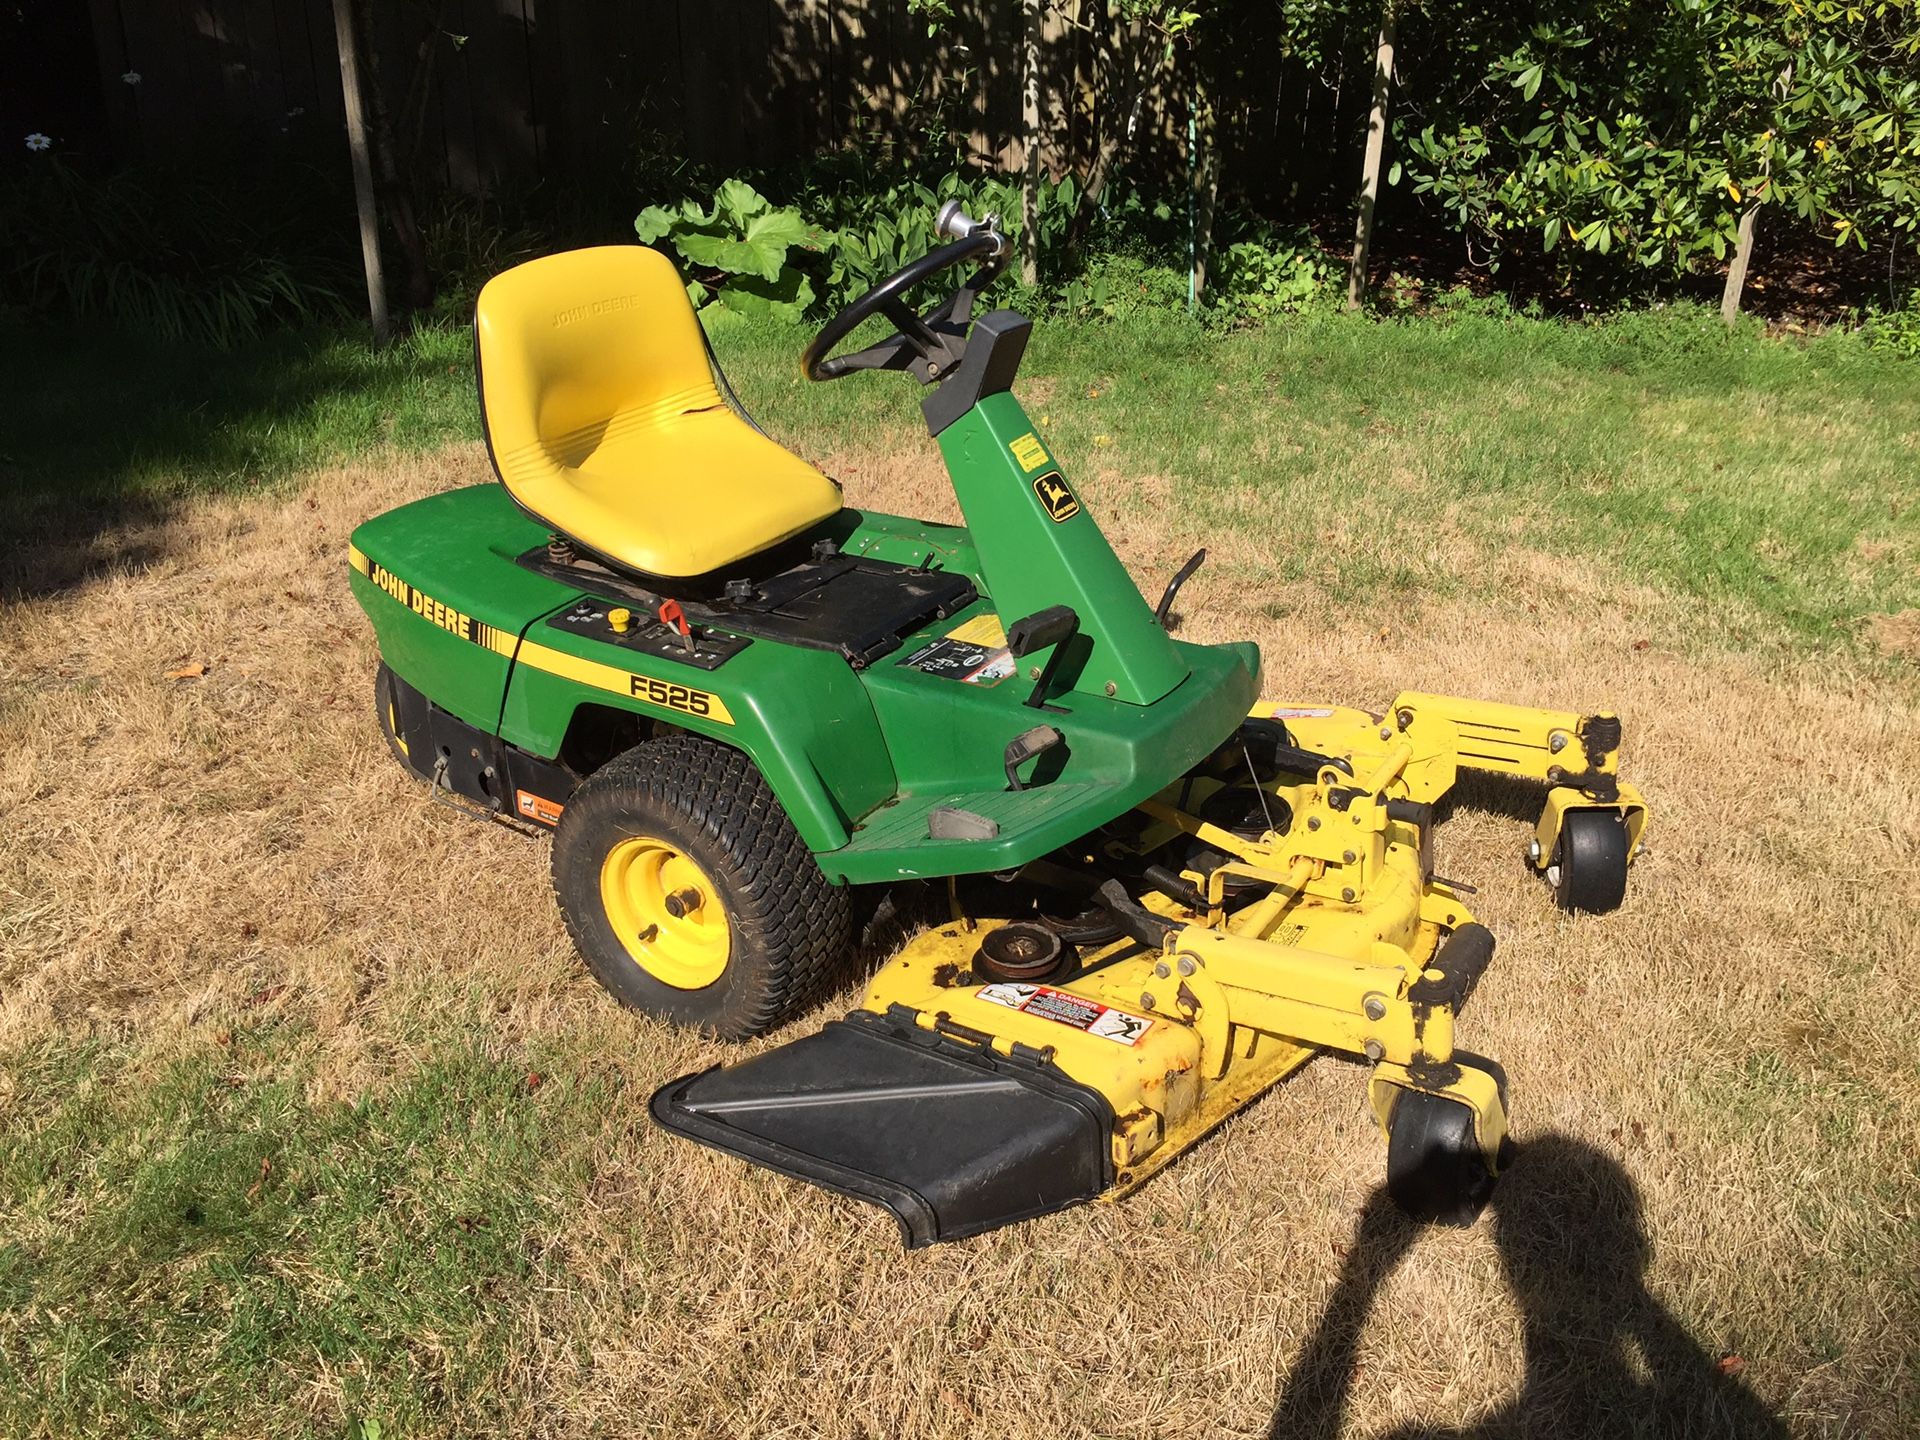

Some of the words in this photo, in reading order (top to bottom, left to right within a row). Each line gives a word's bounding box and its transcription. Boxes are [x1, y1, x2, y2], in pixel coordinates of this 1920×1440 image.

[592, 294, 639, 315] DEERE
[372, 564, 408, 605] JOHN
[412, 588, 470, 640] DEERE
[630, 674, 710, 715] F525
[1058, 993, 1099, 1010] DANGER
